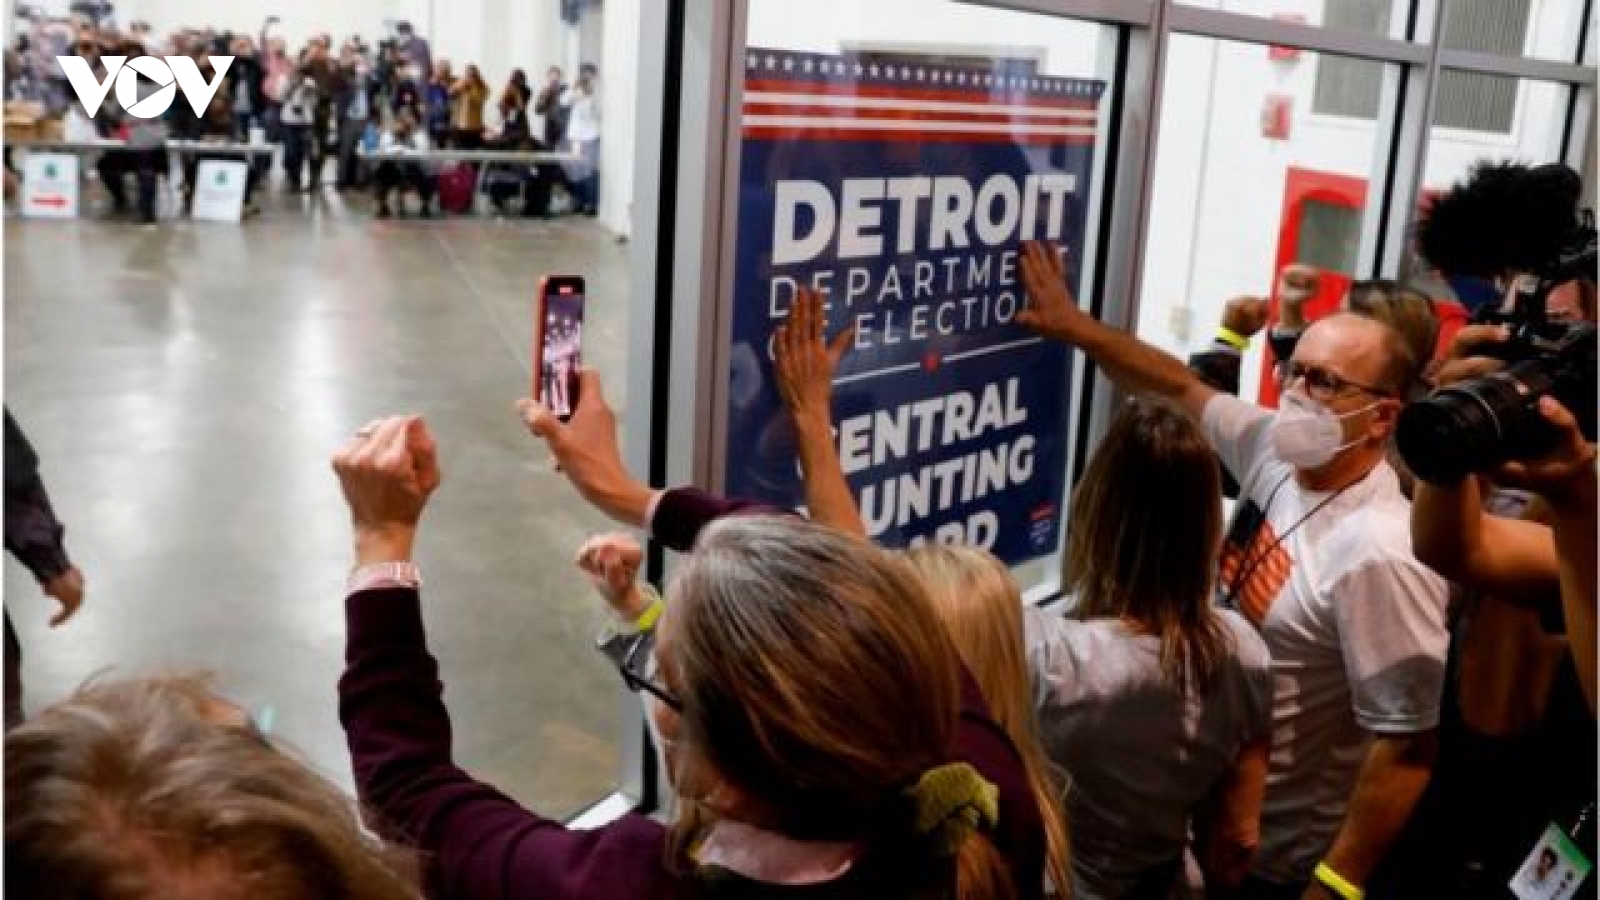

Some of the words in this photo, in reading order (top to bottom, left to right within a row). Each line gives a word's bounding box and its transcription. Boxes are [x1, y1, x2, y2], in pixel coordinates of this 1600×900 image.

[771, 174, 1077, 266] DETROIT
[768, 246, 1070, 319] DEPARTMET
[853, 290, 1028, 350] ELECTIO
[831, 376, 1029, 474] ENTRAL
[797, 434, 1037, 537] UNTING
